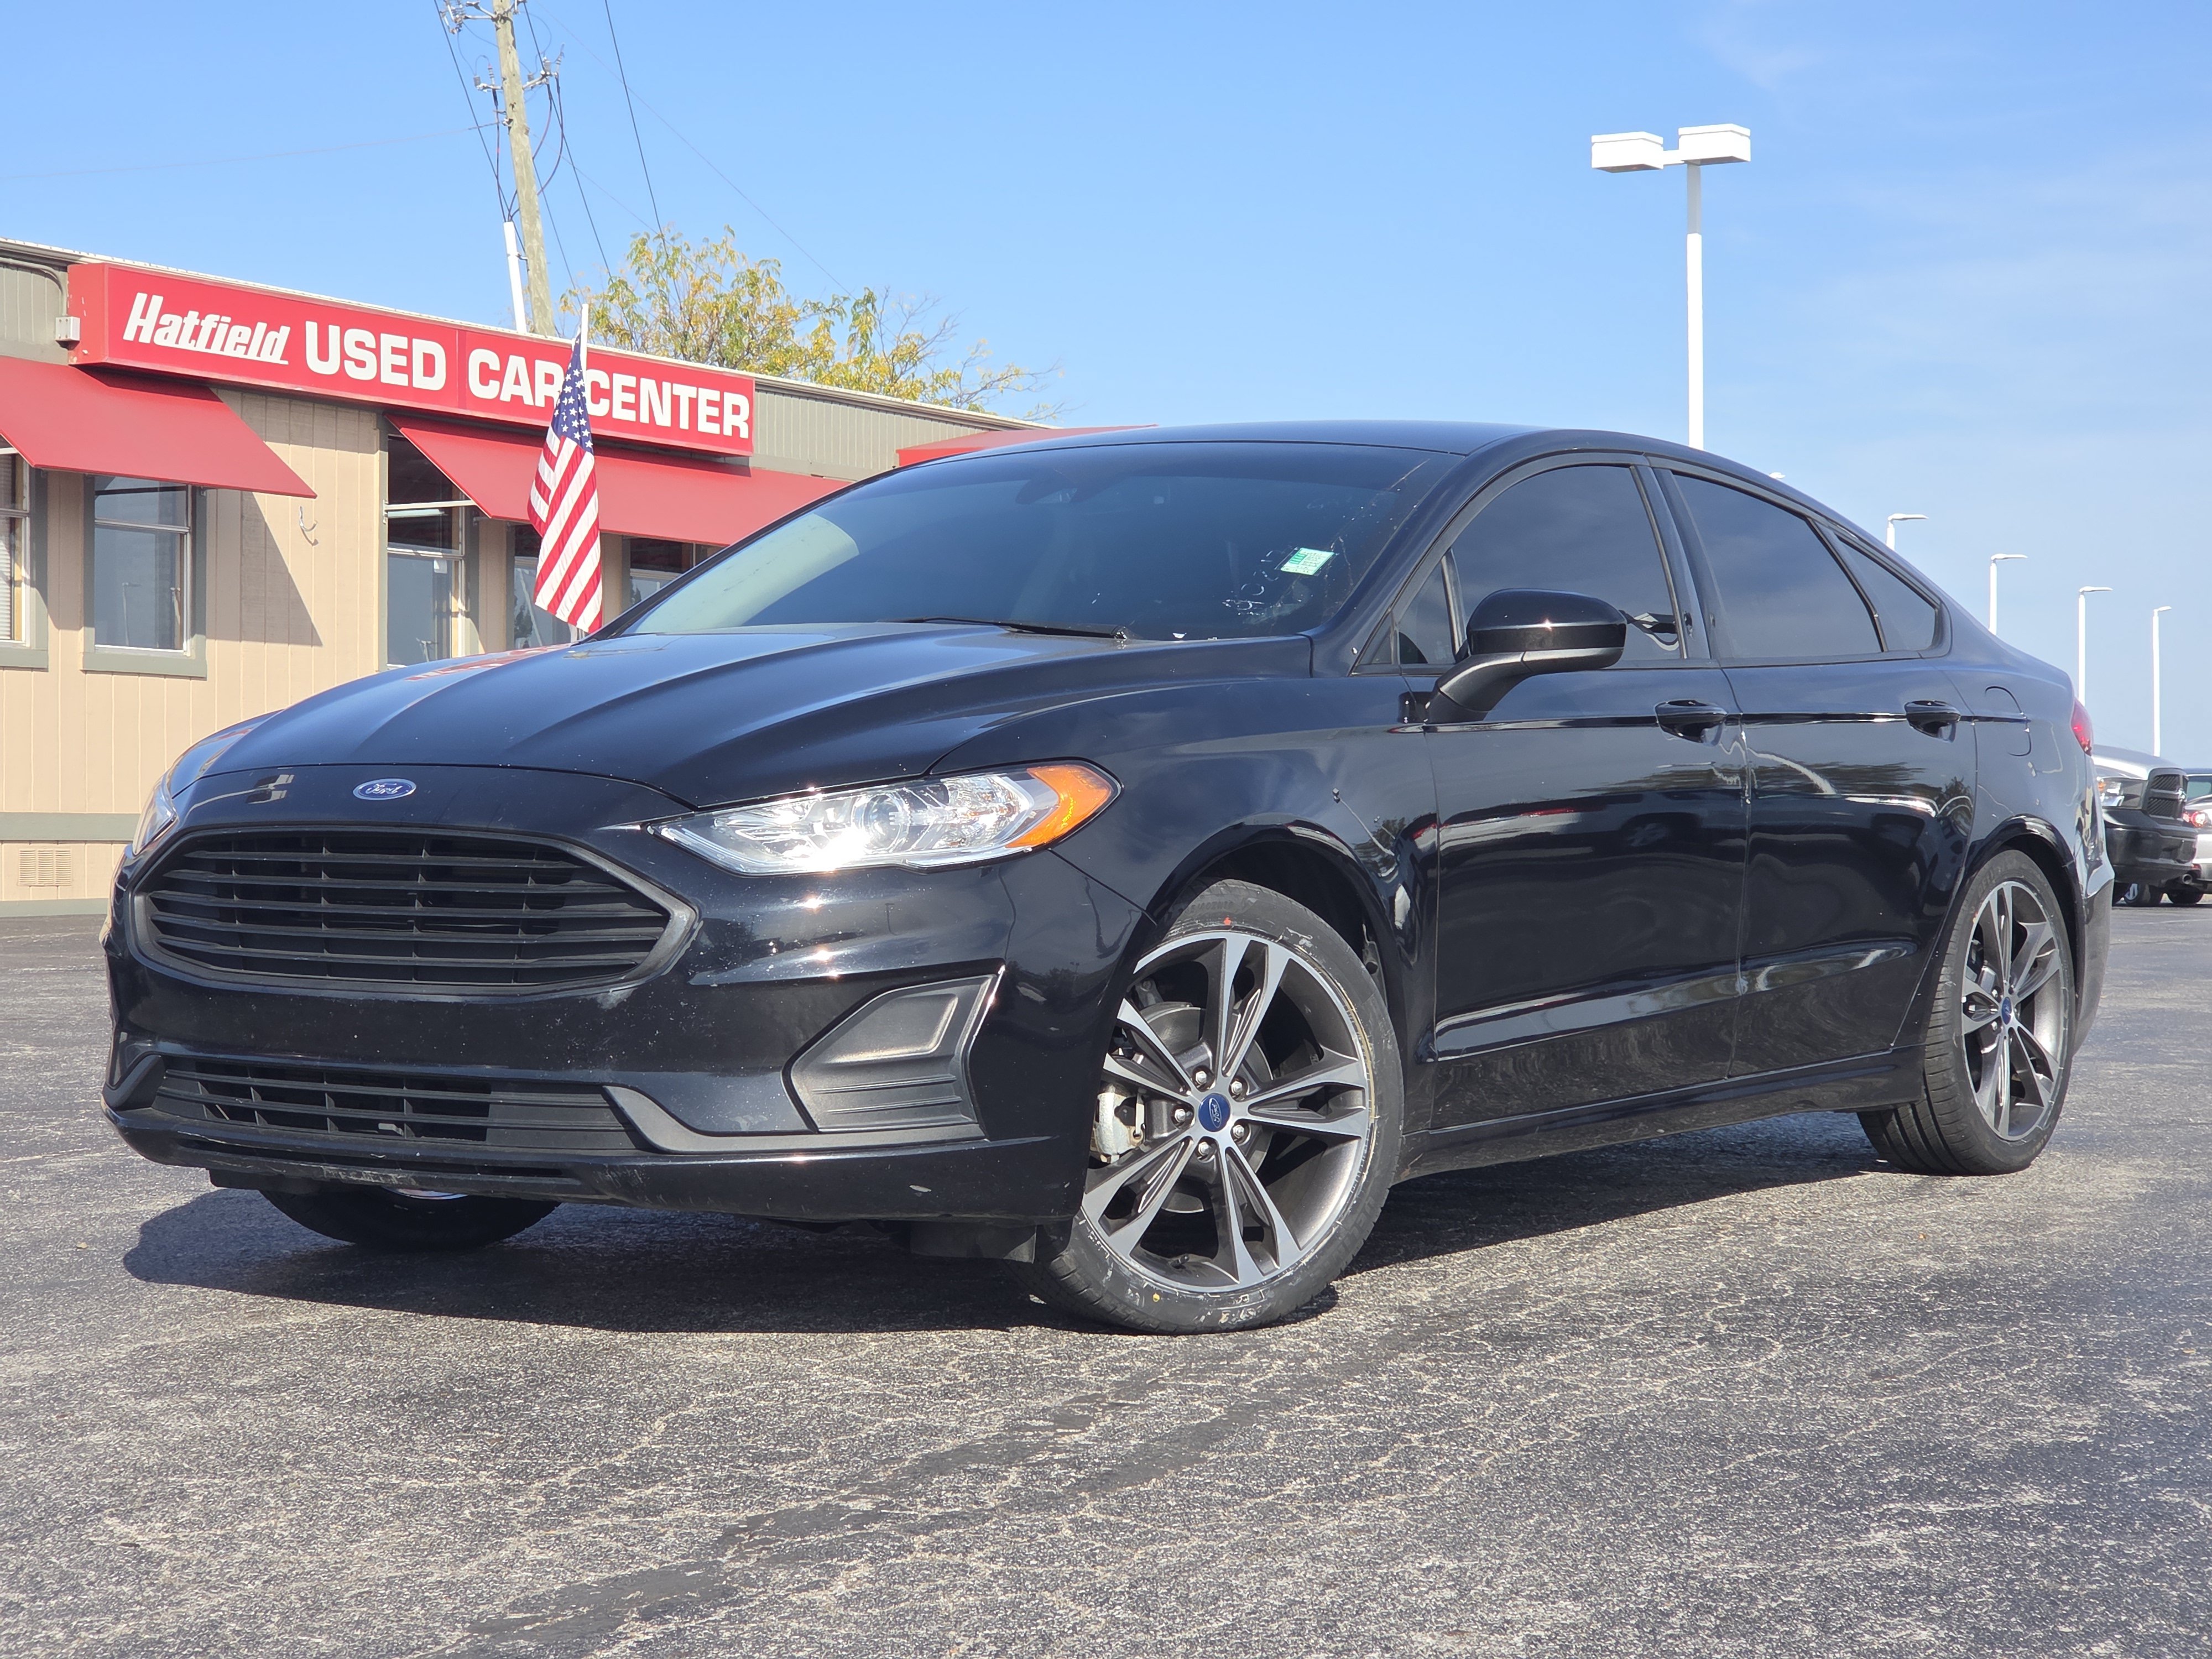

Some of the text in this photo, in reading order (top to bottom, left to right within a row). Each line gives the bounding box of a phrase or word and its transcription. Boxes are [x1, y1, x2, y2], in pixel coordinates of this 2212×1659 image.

[123, 292, 749, 439] Hatfield USED CAR CENTER
[365, 783, 403, 795] Ford
